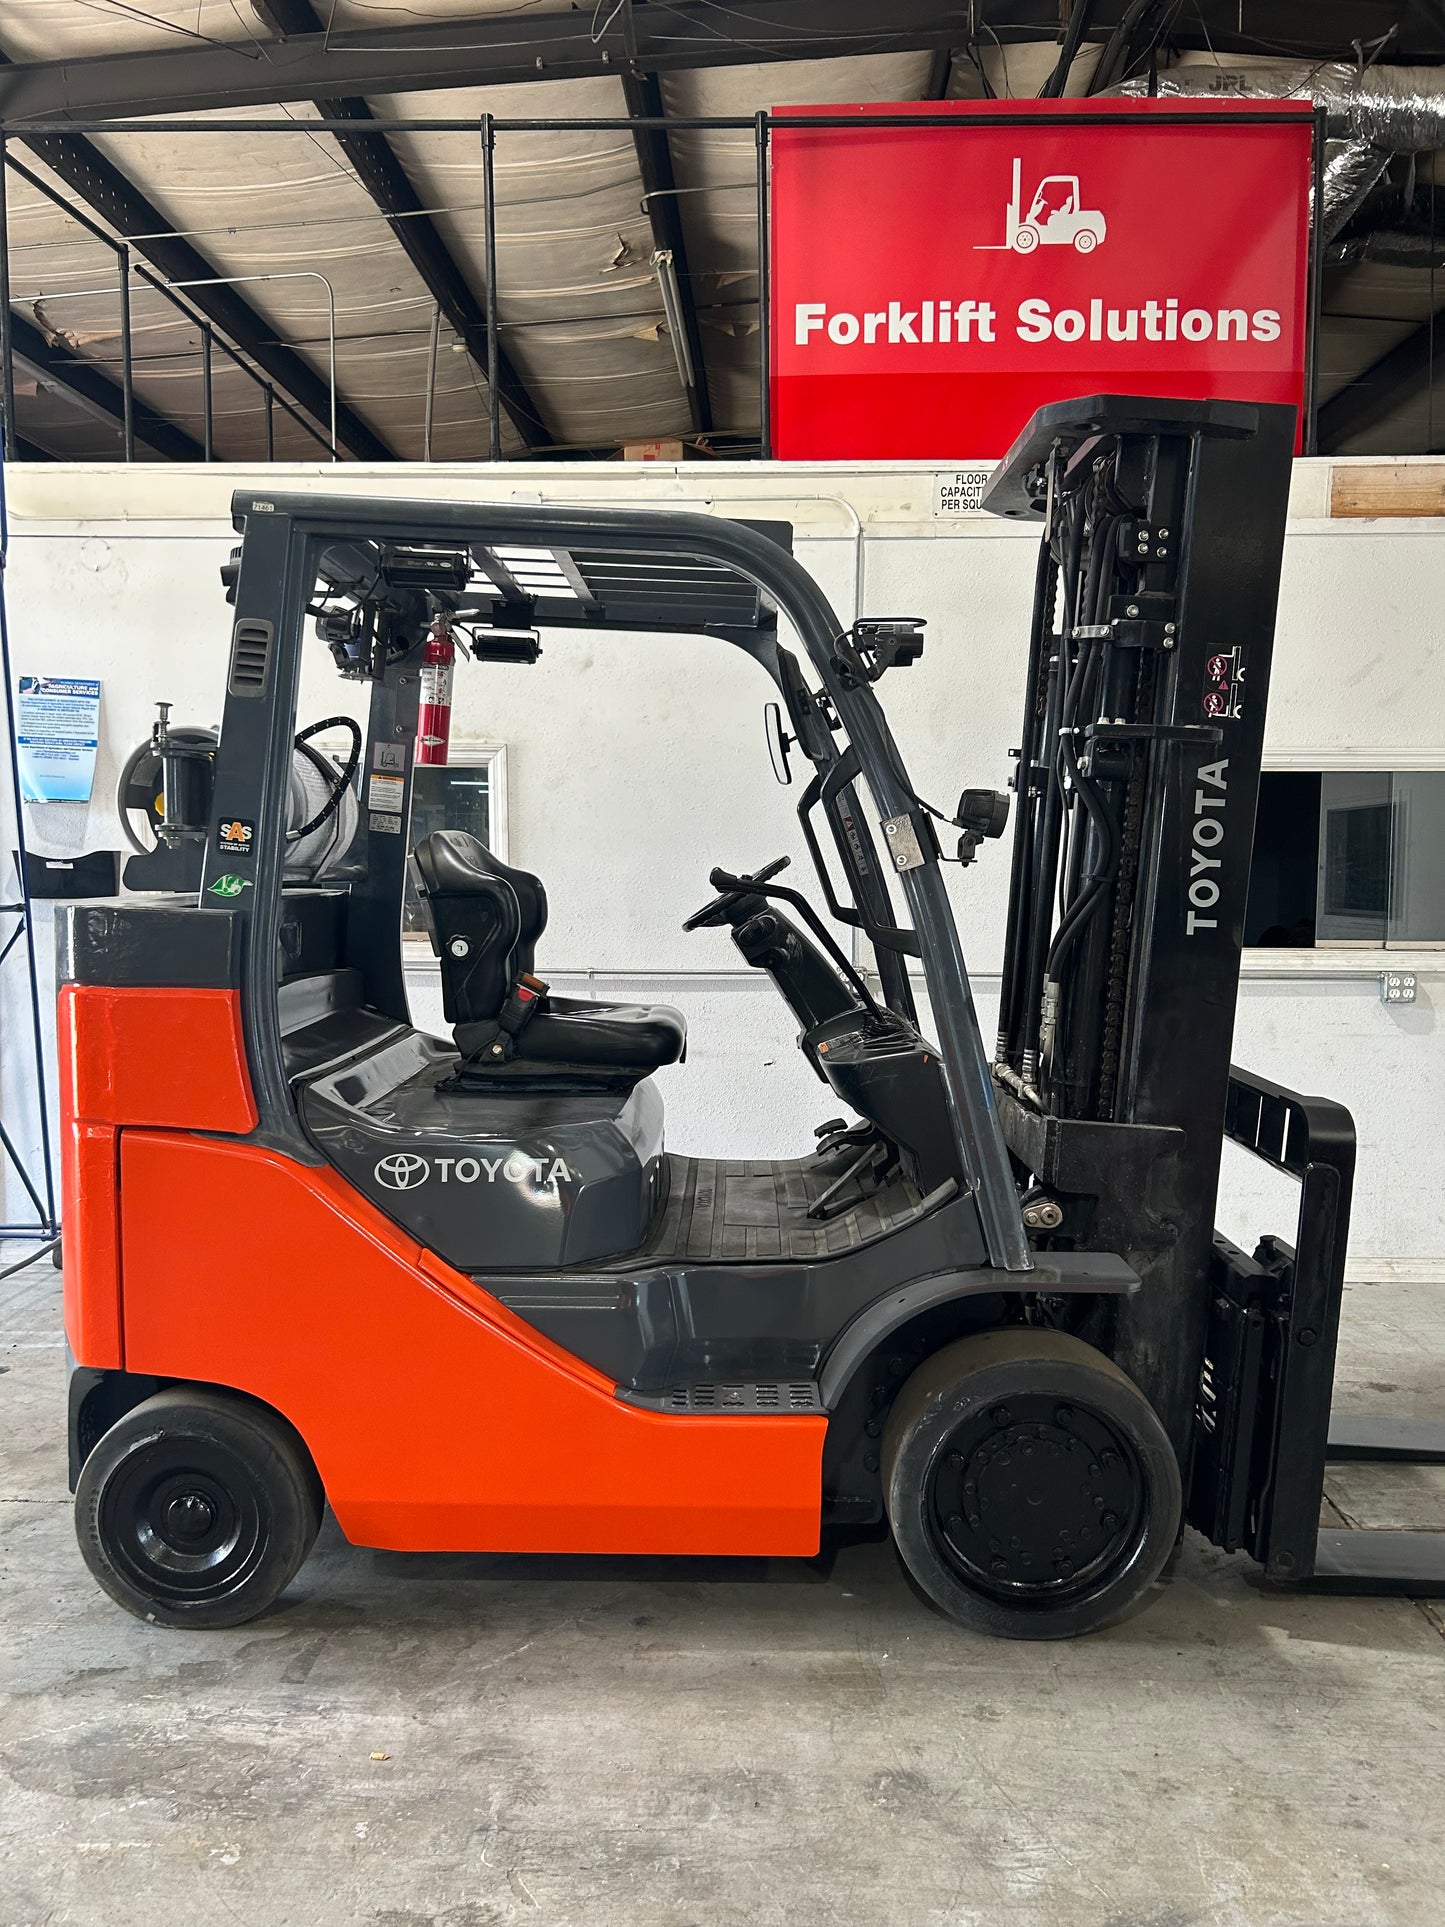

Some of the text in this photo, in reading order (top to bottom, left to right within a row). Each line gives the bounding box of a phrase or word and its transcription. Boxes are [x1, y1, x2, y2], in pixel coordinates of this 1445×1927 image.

[1209, 75, 1253, 91] JPL
[795, 298, 1281, 345] Forklift Solutions
[957, 474, 988, 484] FLOOR
[941, 487, 983, 497] CAPACIT
[941, 499, 982, 510] PER SQU
[220, 821, 252, 842] SAS
[1186, 758, 1230, 936] TOYOTA
[434, 1157, 572, 1183] TOYOTA
